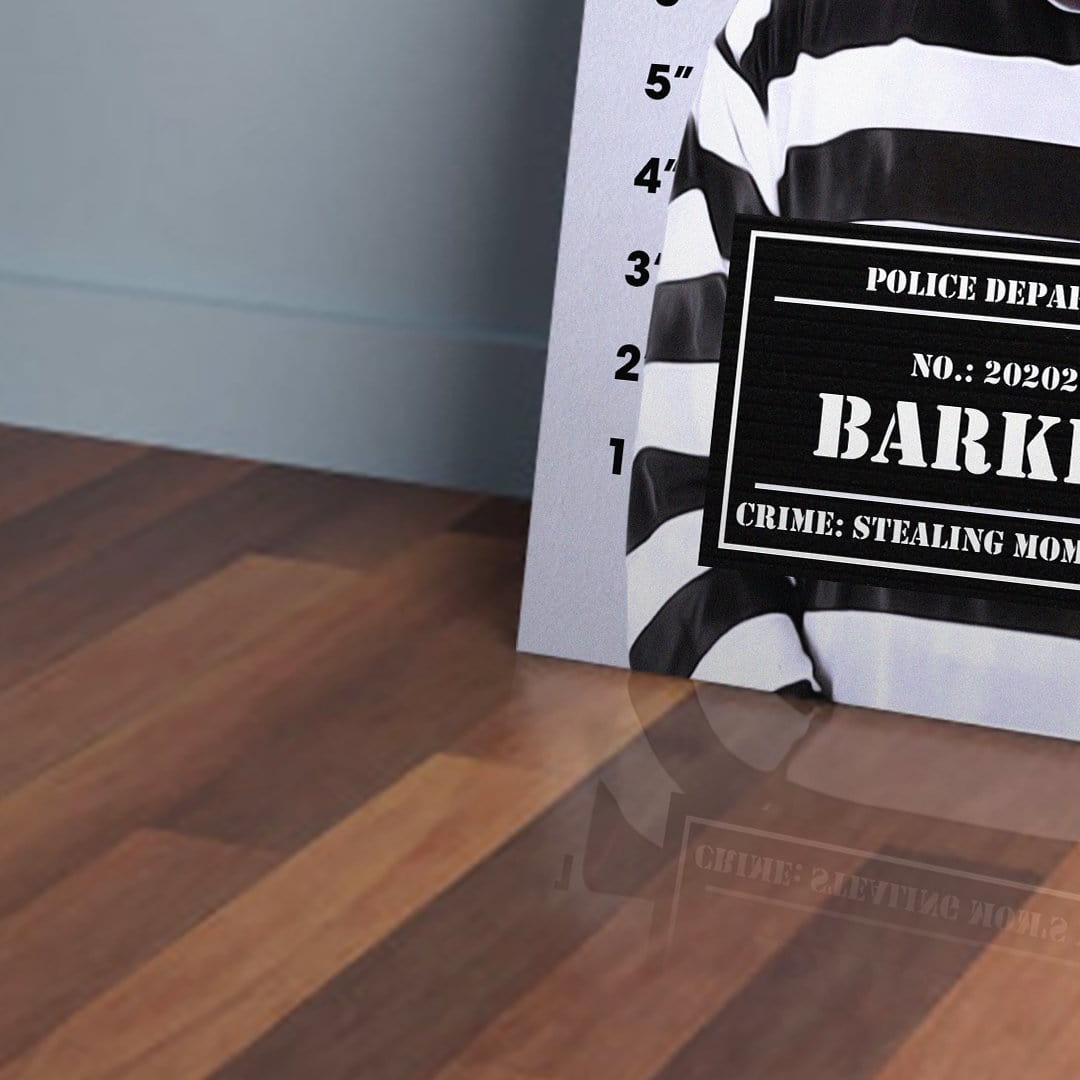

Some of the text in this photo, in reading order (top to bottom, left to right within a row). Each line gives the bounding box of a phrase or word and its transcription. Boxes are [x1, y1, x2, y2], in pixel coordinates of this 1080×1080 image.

[865, 266, 977, 301] POLICE
[910, 352, 974, 384] NO.:
[735, 501, 844, 538] CRIME:
[852, 515, 1005, 555] STEALING
